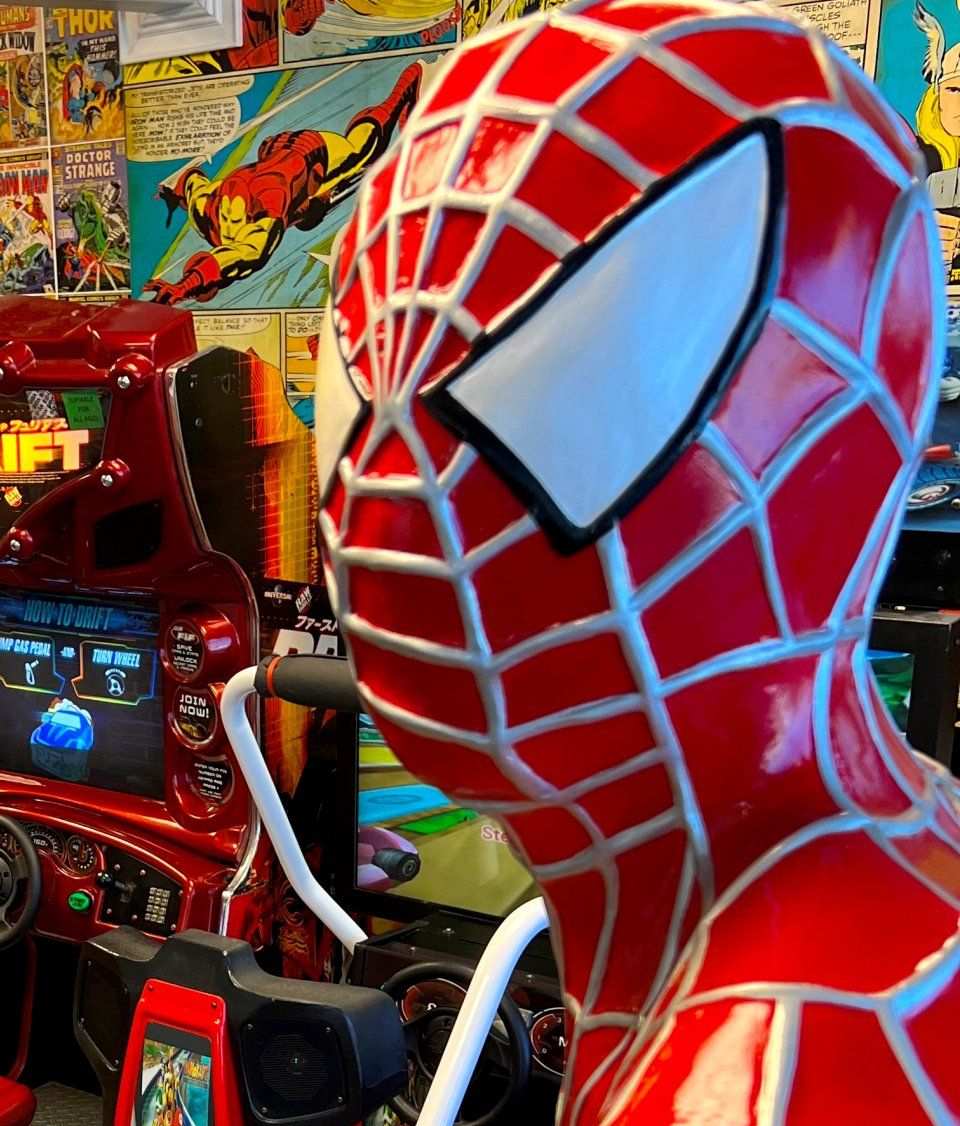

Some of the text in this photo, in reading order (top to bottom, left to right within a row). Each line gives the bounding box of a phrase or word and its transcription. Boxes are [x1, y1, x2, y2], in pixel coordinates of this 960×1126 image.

[827, 0, 867, 10] GOLIATH
[53, 8, 113, 38] THOR
[807, 12, 841, 22] SCLES
[833, 21, 852, 29] THE
[8, 31, 36, 53] WIDOW
[66, 149, 112, 165] DOCTOR
[6, 161, 41, 171] INVINCIBLE
[66, 161, 115, 180] STRANGE
[21, 168, 49, 196] MAN
[24, 601, 114, 630] HOW TO DRIFT
[13, 639, 30, 653] GAS
[30, 641, 51, 657] PEDAL
[93, 648, 140, 667] TURN WHEEL
[179, 694, 207, 707] JOIN
[179, 704, 210, 718] NOW!
[481, 826, 509, 843] Ste
